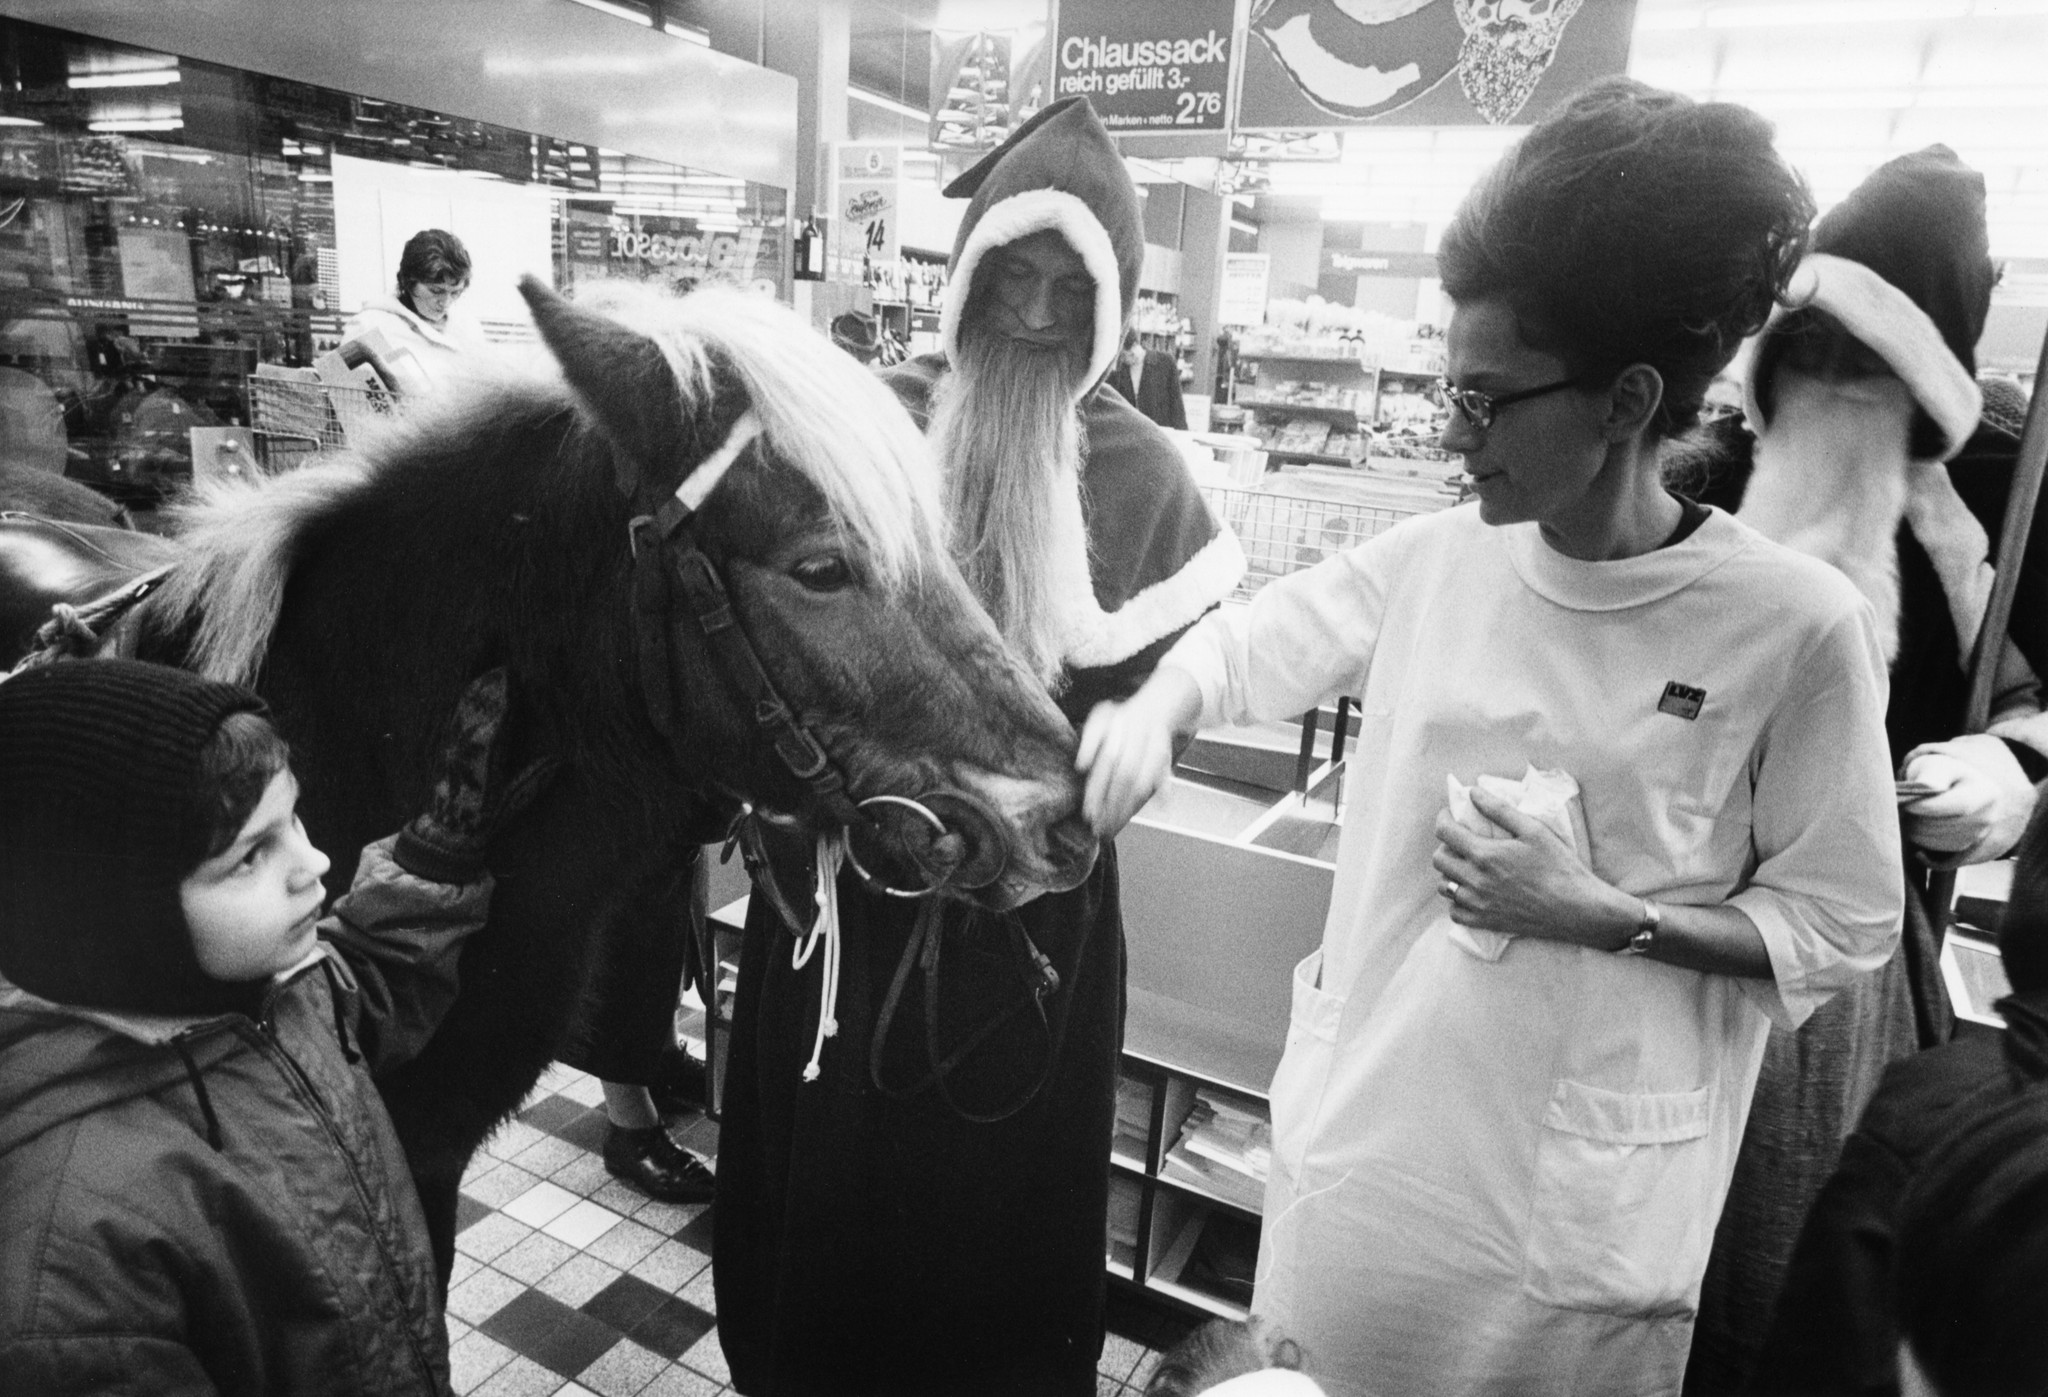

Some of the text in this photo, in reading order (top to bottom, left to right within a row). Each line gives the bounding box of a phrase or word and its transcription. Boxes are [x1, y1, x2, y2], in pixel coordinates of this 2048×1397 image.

[1061, 30, 1227, 70] Chlaussack
[1059, 70, 1103, 93] reich
[1105, 67, 1165, 95] gefüllt
[1109, 113, 1143, 126] Marken
[1148, 113, 1174, 125] netto
[865, 219, 885, 251] 14
